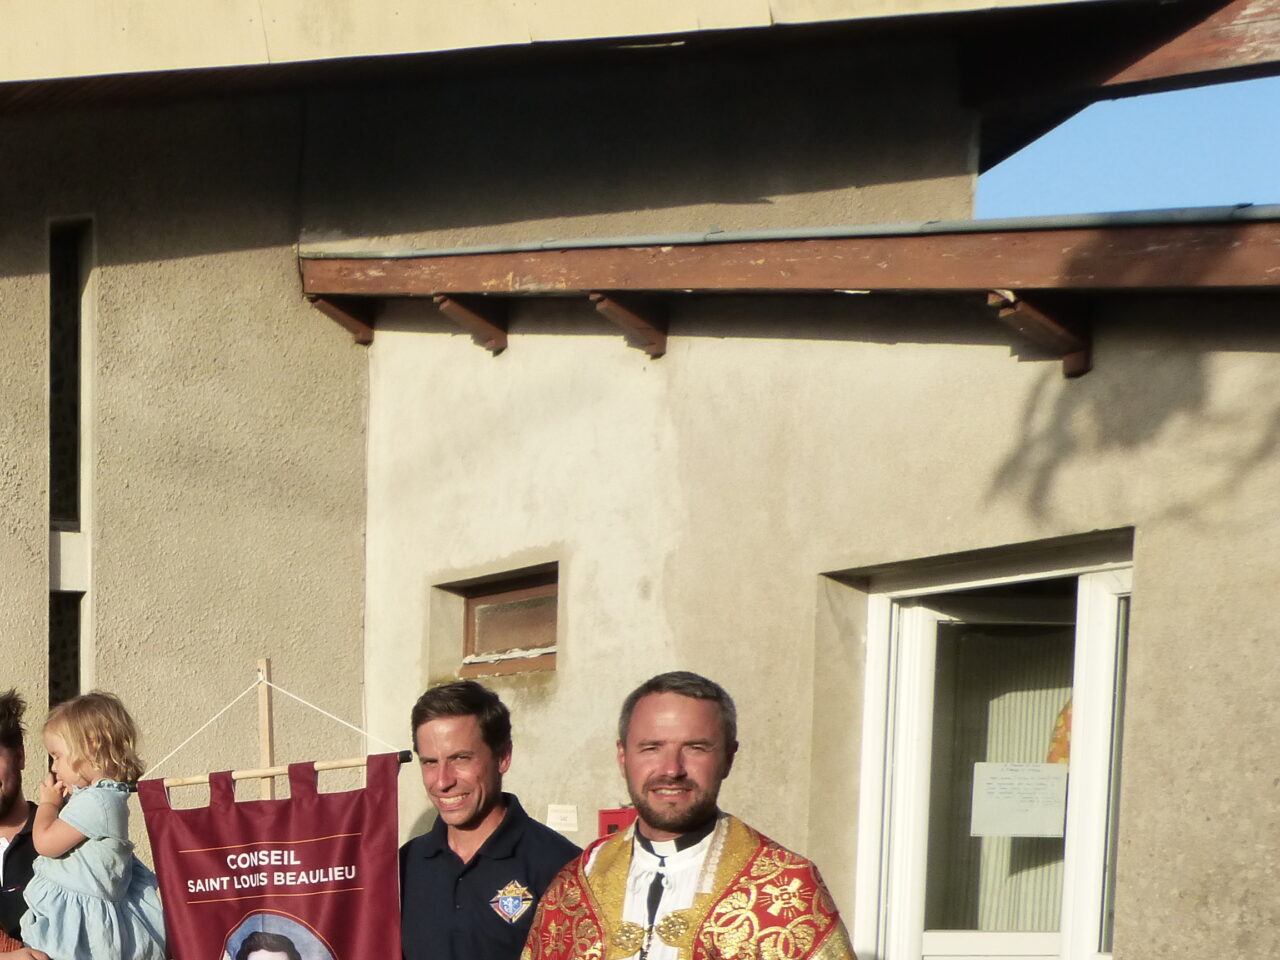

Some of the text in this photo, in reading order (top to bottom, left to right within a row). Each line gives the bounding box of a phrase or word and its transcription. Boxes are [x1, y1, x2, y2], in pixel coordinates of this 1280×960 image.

[226, 850, 301, 870] CONSEIL
[187, 865, 357, 893] SAINT LOUIS BEAULIEU
